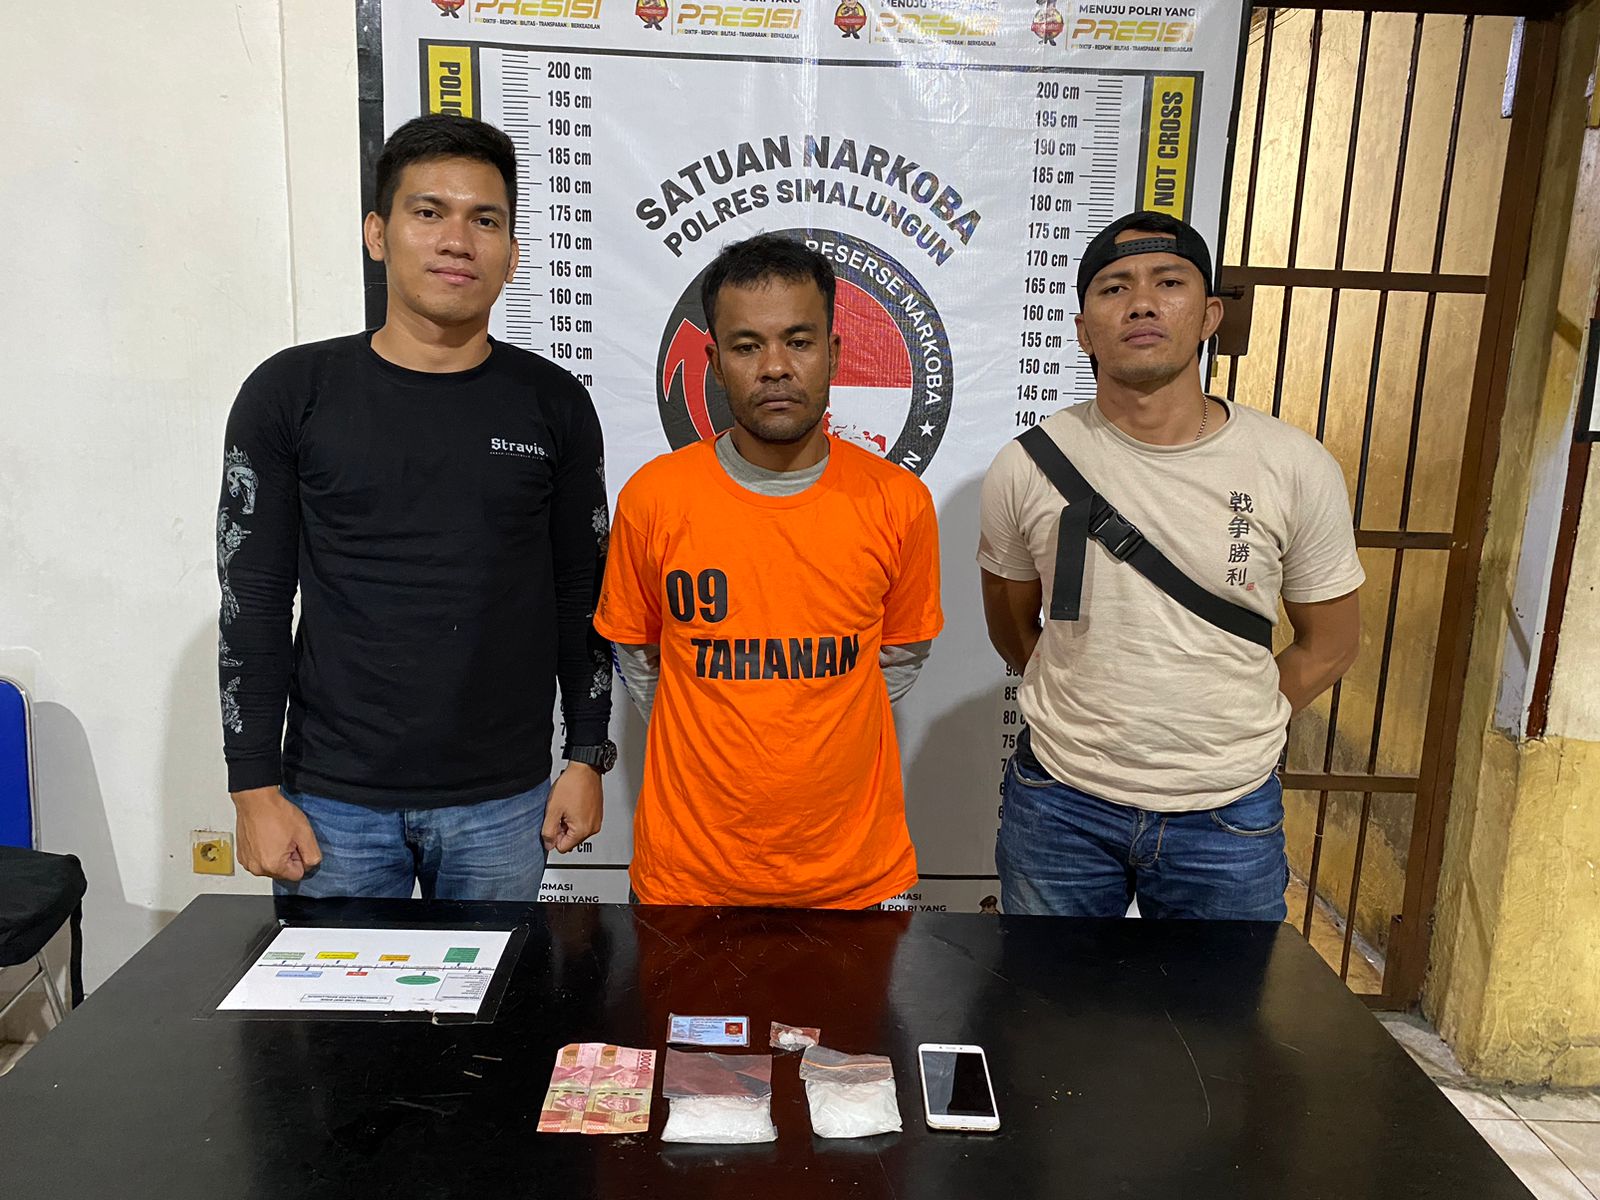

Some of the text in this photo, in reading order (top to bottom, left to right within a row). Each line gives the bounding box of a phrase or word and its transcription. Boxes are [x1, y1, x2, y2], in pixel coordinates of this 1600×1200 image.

[677, 4, 802, 29] PRESISI
[1079, 5, 1196, 17] MENUJU POLRI YANG
[1072, 19, 1195, 42] PRESISI
[547, 61, 592, 80] 200 cm
[1036, 81, 1080, 100] 200 cm
[548, 91, 592, 109] 195 cm
[548, 119, 592, 137] 190 cm
[1035, 111, 1078, 128] 195 cm
[548, 147, 592, 165] 185 cm
[1034, 138, 1076, 156] 190 cm
[1154, 91, 1184, 207] NOT CROSS
[1032, 166, 1074, 184] 185 cm
[549, 176, 592, 194] 180 cm
[635, 134, 982, 245] SATUAN NARKOBA
[1030, 194, 1072, 212] 180 cm
[549, 204, 592, 222] 175 cm
[663, 178, 955, 267] POLRES SIMALUNGUN
[1028, 222, 1070, 240] 175 cm
[549, 232, 592, 250] 170 cm
[1026, 250, 1068, 267] 170 cm
[549, 260, 592, 278] 165 cm
[1024, 277, 1066, 294] 165 cm
[550, 288, 592, 305] 160 cm
[1022, 305, 1064, 321] 160 cm
[550, 316, 592, 333] 155 cm
[1020, 332, 1062, 348] 155 cm
[550, 343, 592, 360] 150 cm
[900, 294, 941, 406] NARKOBA
[1019, 359, 1060, 375] 150 cm
[1017, 385, 1058, 401] 145 cm
[1015, 411, 1036, 427] 140
[1225, 490, 1253, 586] 戦争勝利
[666, 568, 728, 623] 09
[691, 633, 859, 680] TAHANAN
[1005, 686, 1018, 700] 85
[1003, 710, 1016, 724] 80
[1002, 734, 1015, 748] 75
[577, 841, 593, 853] cm
[540, 883, 573, 891] RMASI
